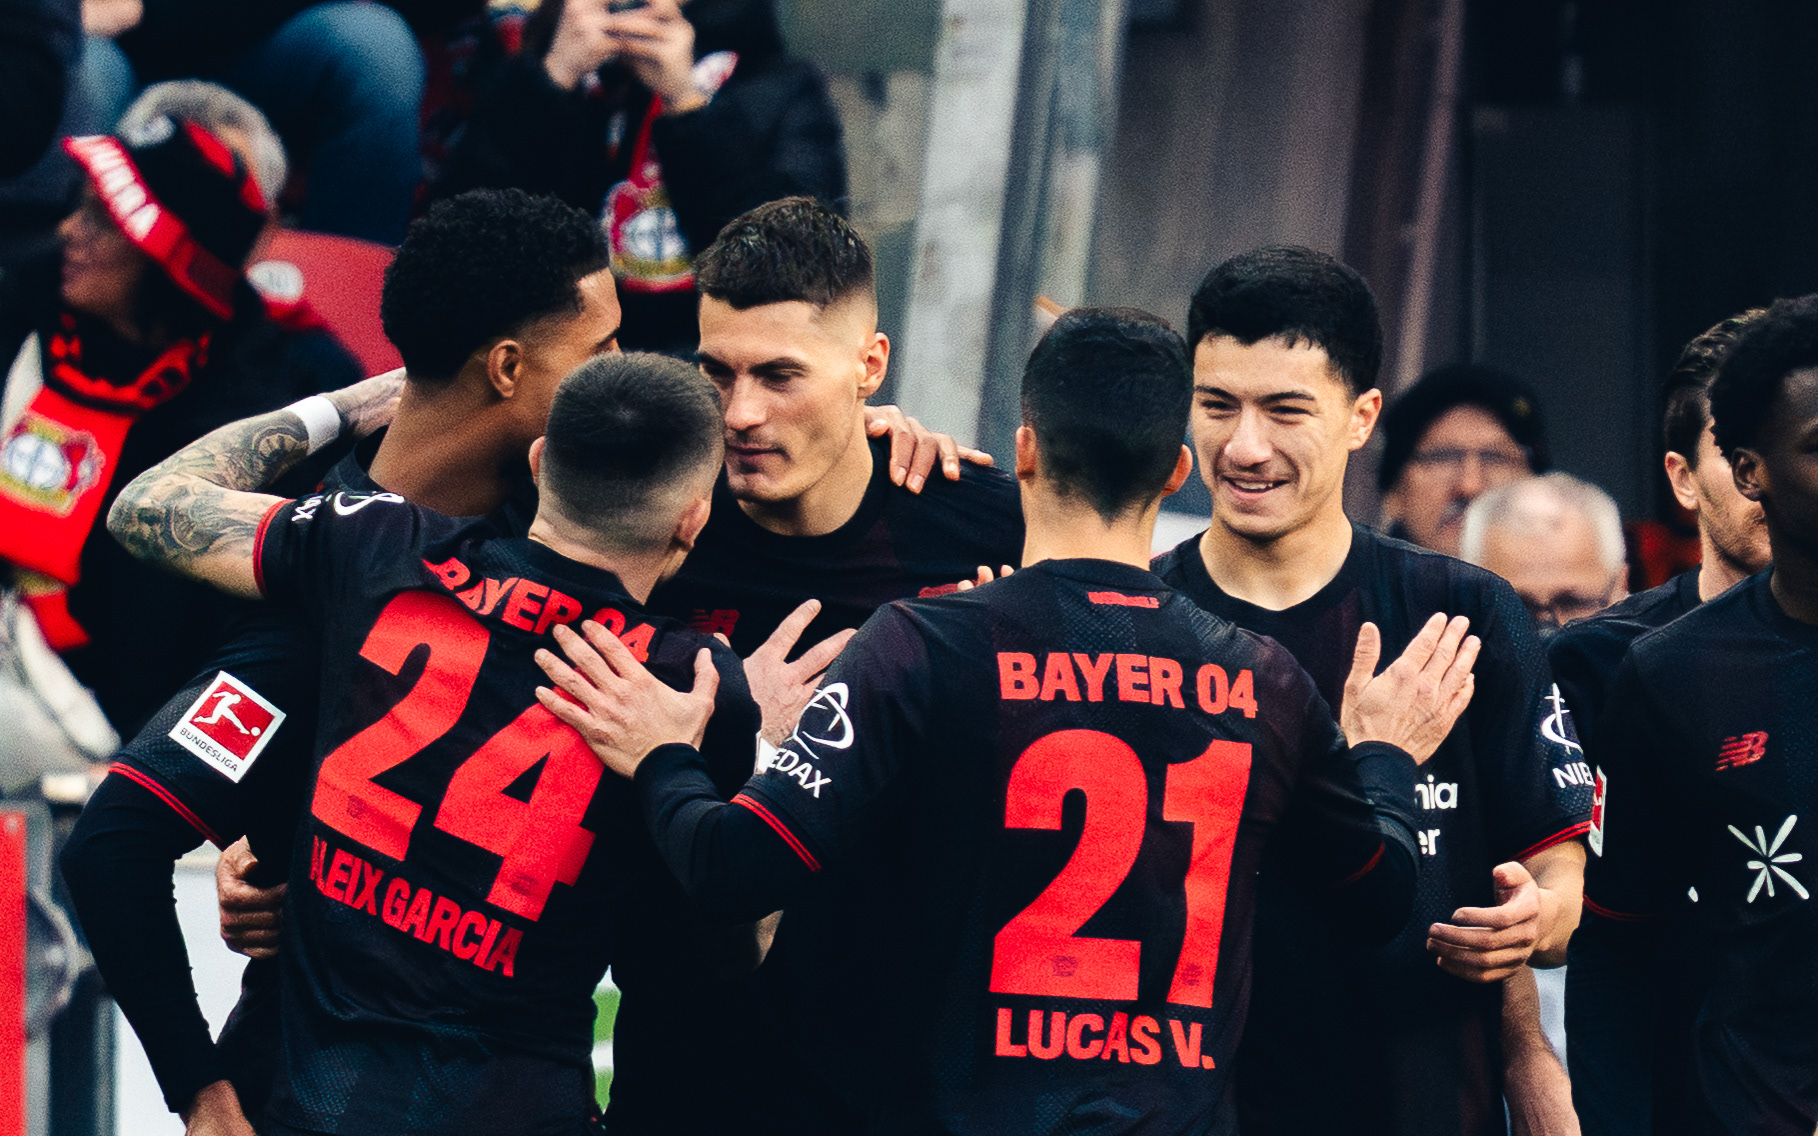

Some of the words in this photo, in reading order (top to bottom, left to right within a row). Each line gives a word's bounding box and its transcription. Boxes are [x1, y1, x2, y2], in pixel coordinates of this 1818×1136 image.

[423, 556, 582, 635] BAYER
[997, 652, 1186, 709] BAYER
[1195, 664, 1259, 719] 04
[180, 726, 239, 773] BUNDESLIGA
[311, 589, 604, 922] 24
[988, 728, 1253, 1009] 21
[382, 877, 524, 978] GARCIA
[995, 1008, 1163, 1065] LUCAS
[1168, 1019, 1216, 1070] V.
